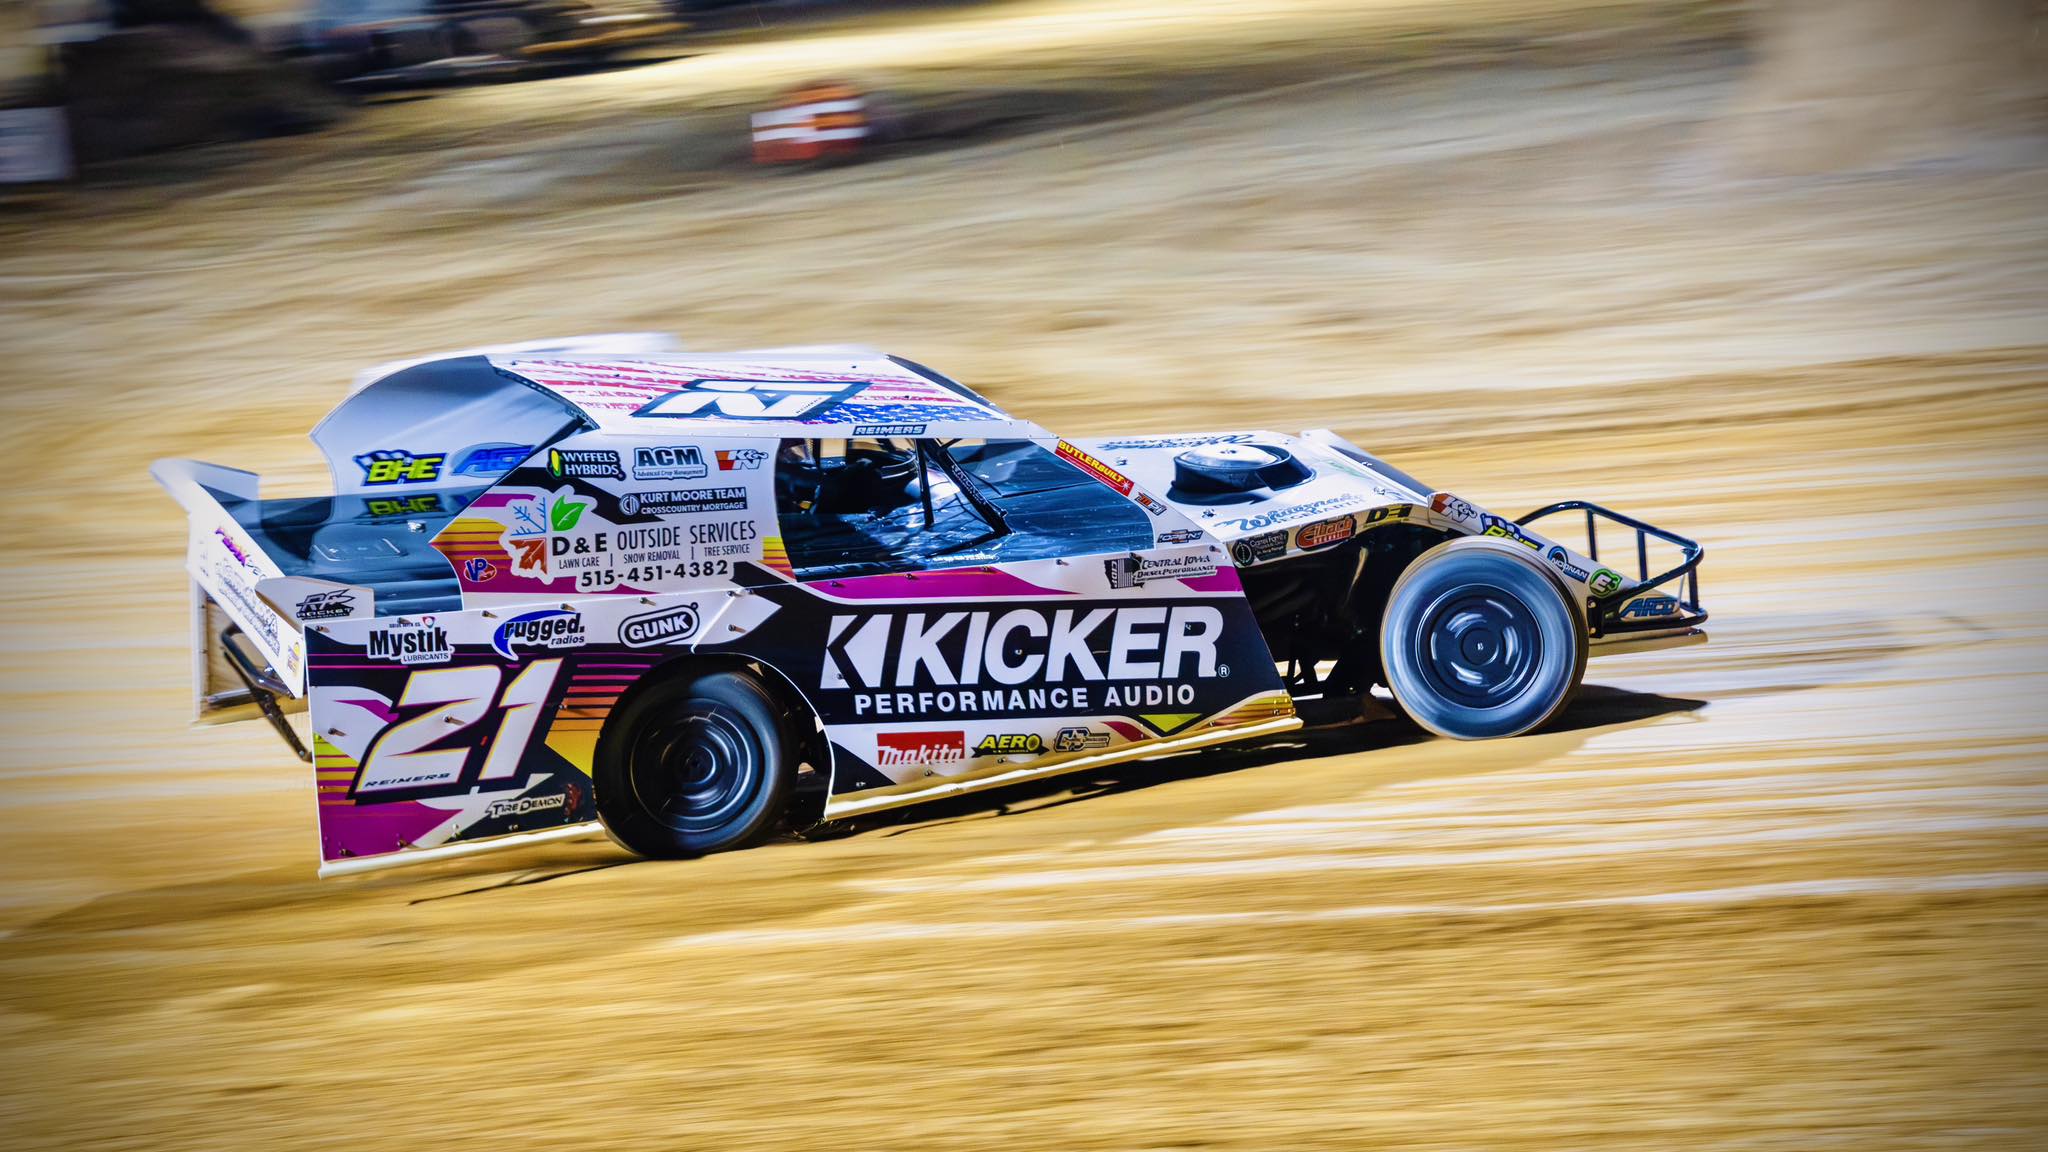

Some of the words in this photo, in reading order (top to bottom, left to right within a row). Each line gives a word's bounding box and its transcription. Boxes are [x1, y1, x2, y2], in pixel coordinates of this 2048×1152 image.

[855, 425, 924, 434] REIMERS
[562, 451, 618, 463] WYFFELS
[638, 448, 698, 467] ACM
[727, 449, 769, 471] K&N
[1058, 440, 1126, 483] BUTLERBUILT
[368, 457, 443, 483] BHE
[564, 463, 620, 476] HYBRIDS
[640, 492, 670, 504] KURT
[670, 489, 713, 502] MOORE
[712, 487, 746, 500] TEAM
[641, 504, 701, 515] CROSSCOUNTRY
[702, 501, 744, 511] MORTGAGE
[1447, 493, 1478, 523] K&N
[617, 526, 681, 550] OUTSIDE
[690, 520, 757, 545] SERVICES
[623, 552, 645, 564] SNOW
[646, 550, 680, 562] REMOVAL
[704, 545, 721, 556] TREE
[721, 543, 751, 556] SERVICE
[465, 558, 488, 582] VP
[558, 558, 580, 569] LAWN
[581, 556, 600, 567] CARE
[1142, 557, 1183, 569] CENTRAL
[1551, 556, 1588, 580] NOONAN
[581, 560, 729, 587] 515-451-4382
[628, 613, 690, 641] GUNK
[369, 625, 449, 657] Mystik
[550, 634, 585, 646] radios
[895, 604, 1226, 688] KICKER
[403, 652, 449, 662] LUBRICANTS
[855, 688, 1089, 716] PERFORMANCE
[1104, 683, 1196, 707] AUDIO
[354, 656, 565, 794] 21
[978, 733, 1042, 751] AERO
[364, 772, 451, 788] REIMERS
[492, 801, 518, 817] TIRE
[518, 795, 564, 812] DEMON
